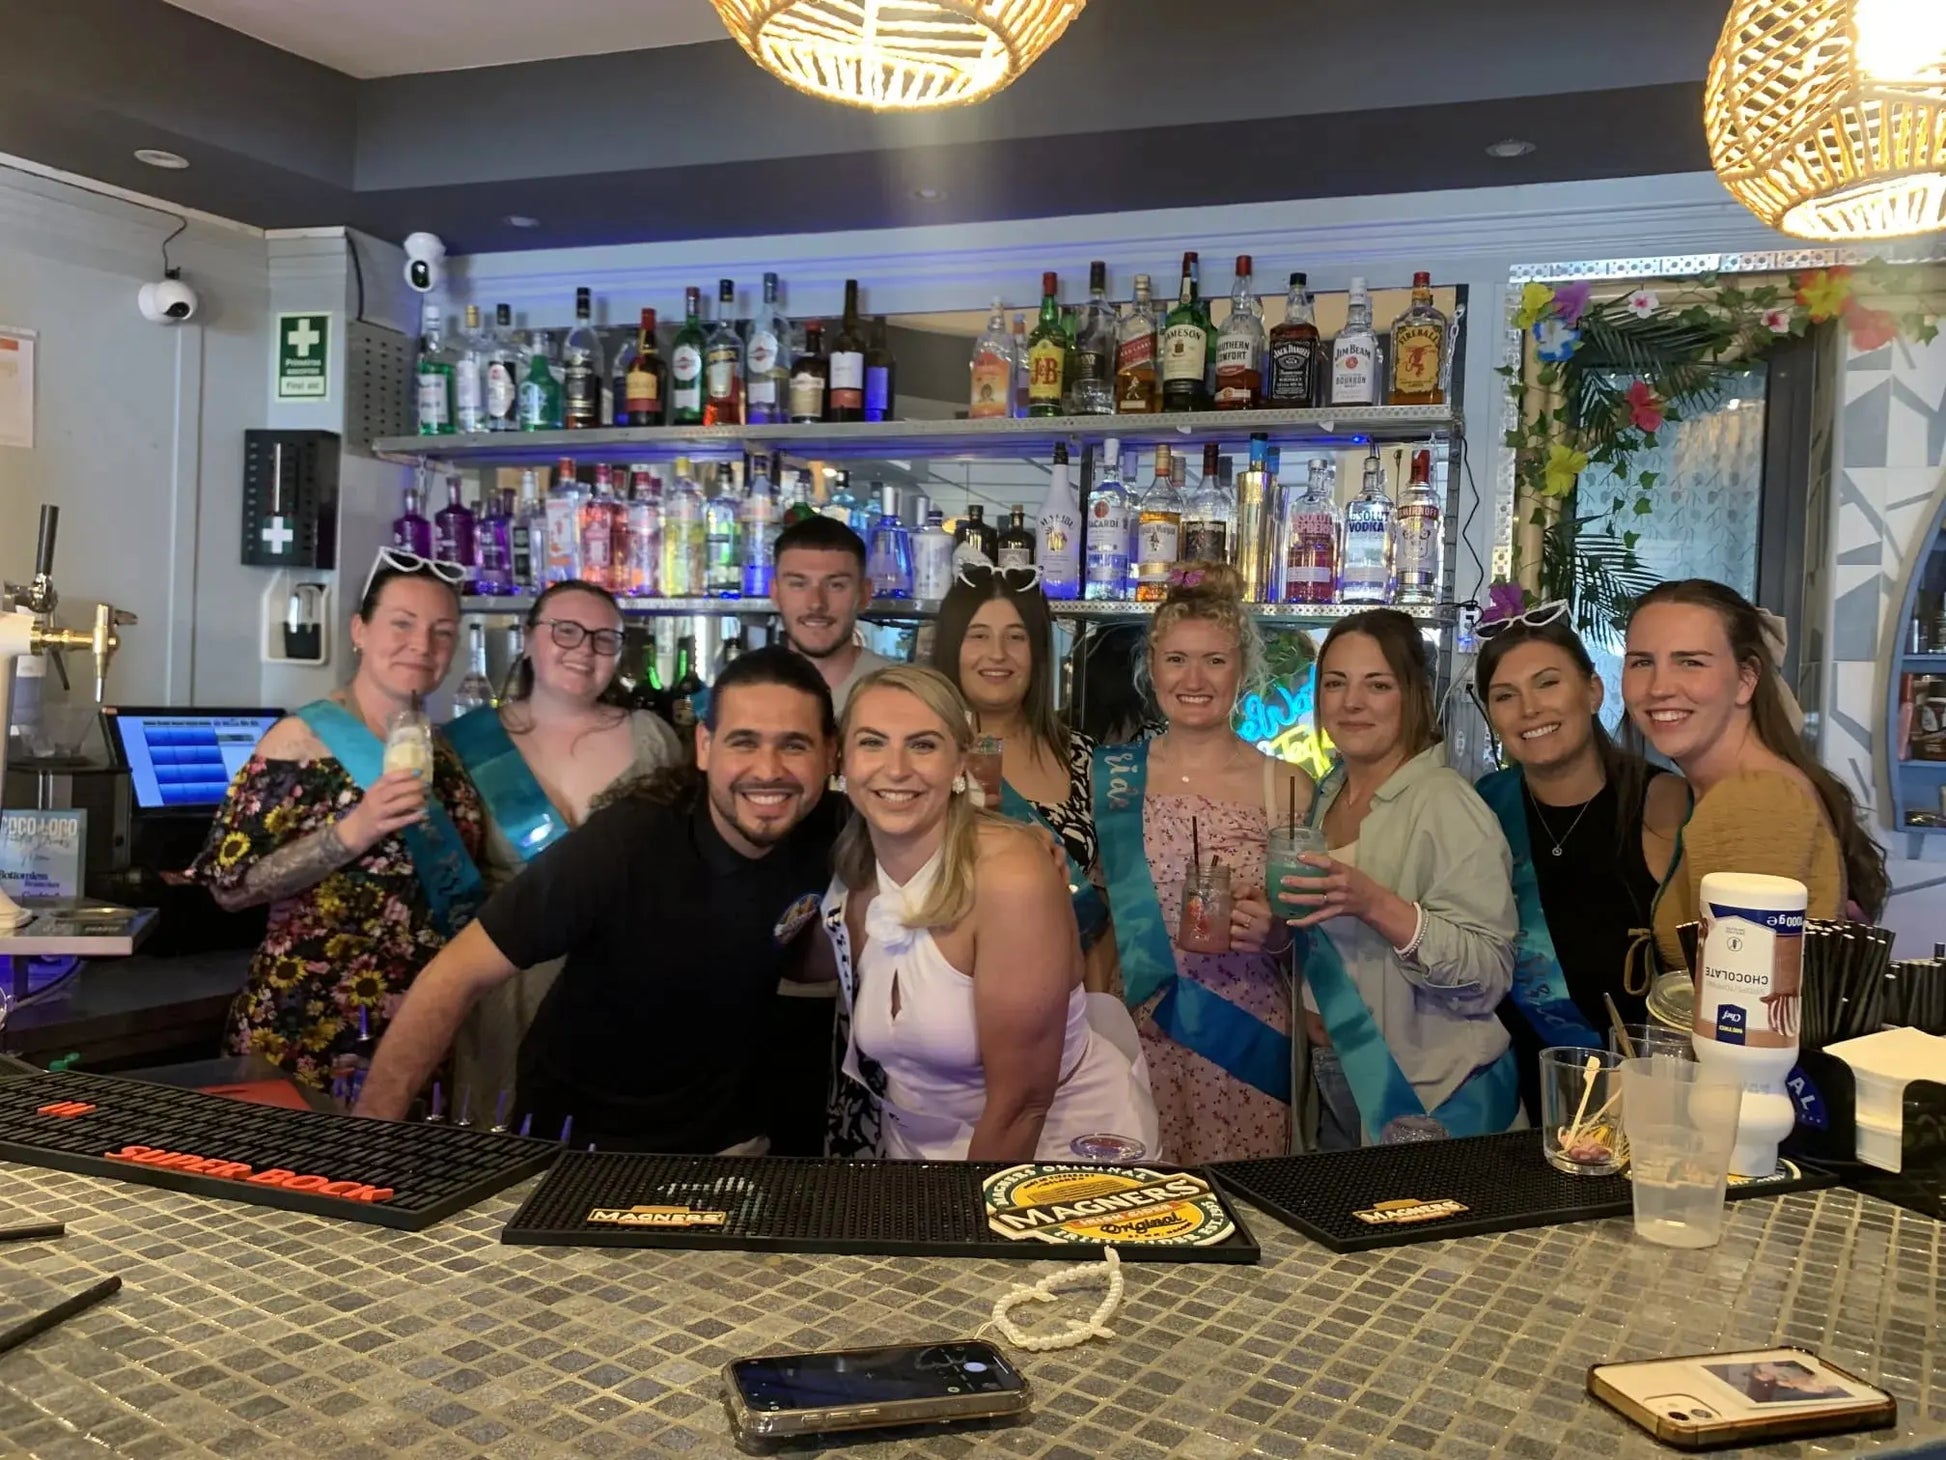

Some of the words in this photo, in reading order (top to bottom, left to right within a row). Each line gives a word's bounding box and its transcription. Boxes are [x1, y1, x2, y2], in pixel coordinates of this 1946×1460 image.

[1335, 346, 1349, 362] JIM
[1349, 343, 1371, 360] BEAM
[1349, 521, 1385, 533] VODKA
[1705, 966, 1769, 985] CHOCOLATE
[1722, 1010, 1742, 1023] Chef
[105, 1145, 253, 1180] SUPER
[248, 1169, 394, 1203] BOCK
[998, 1179, 1201, 1230] MAGNERS
[1360, 1201, 1463, 1222] MAGNERS
[591, 1210, 724, 1225] MAGNERS
[1100, 1211, 1182, 1234] Original
